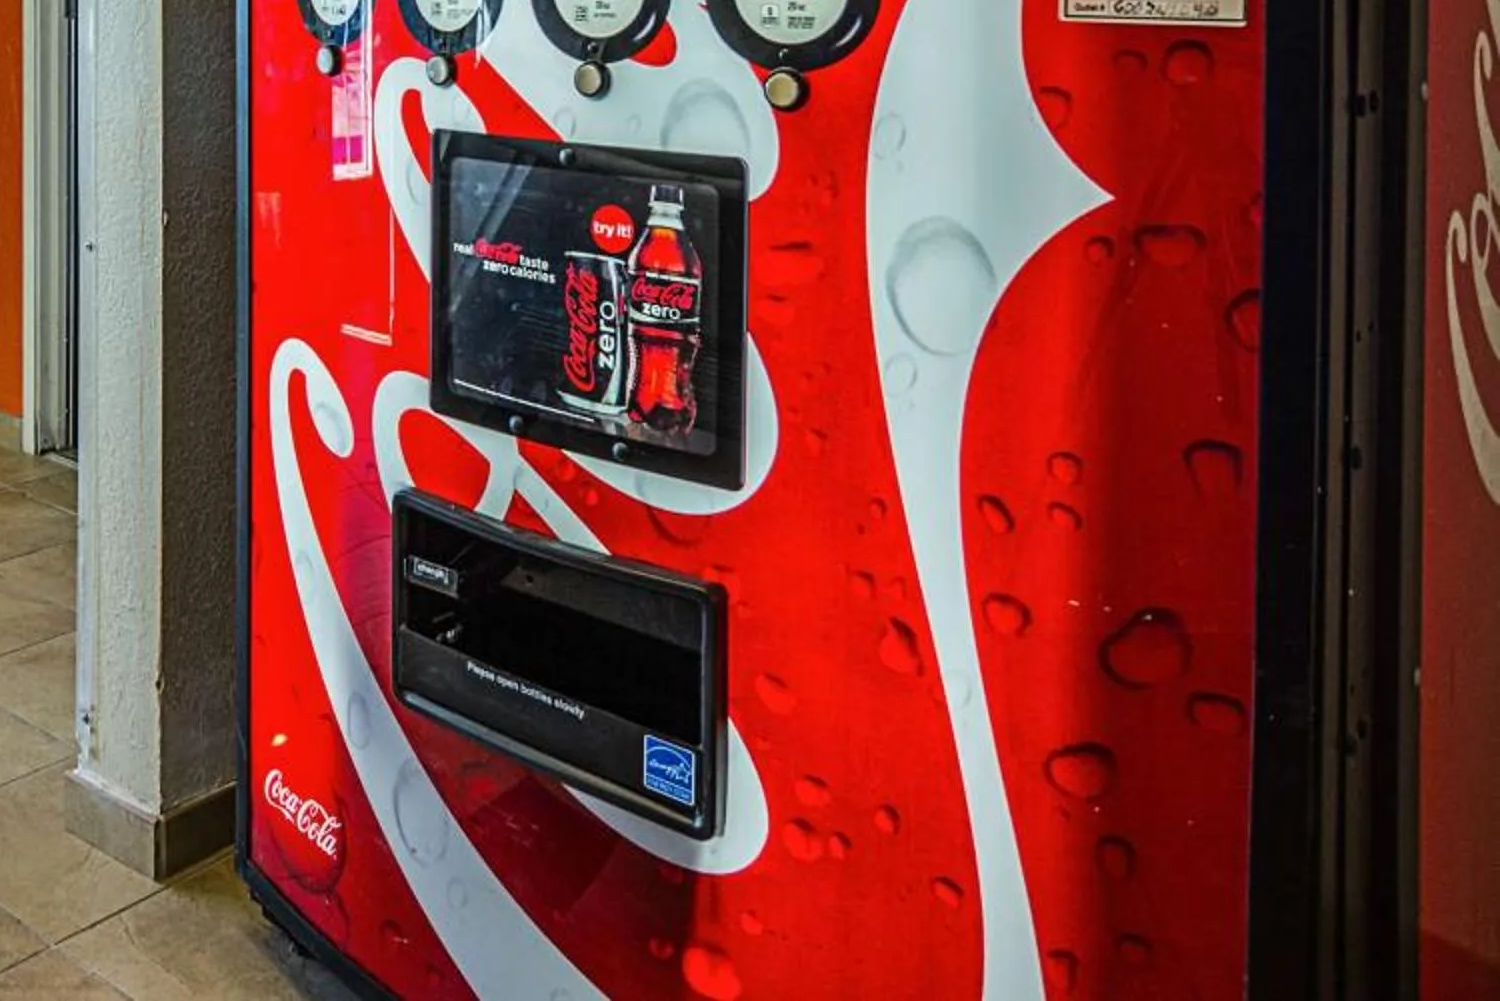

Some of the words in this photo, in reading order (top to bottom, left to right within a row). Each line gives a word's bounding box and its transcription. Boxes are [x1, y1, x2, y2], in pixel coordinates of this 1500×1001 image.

[593, 220, 615, 238] try
[616, 223, 631, 240] it!
[483, 260, 509, 275] zero
[510, 266, 556, 284] calories
[519, 254, 549, 271] taste
[642, 302, 681, 320] zero
[598, 300, 616, 370] zero
[467, 660, 495, 682] Please
[496, 675, 519, 692] open
[520, 682, 553, 706] bottles
[553, 698, 585, 721] slowly
